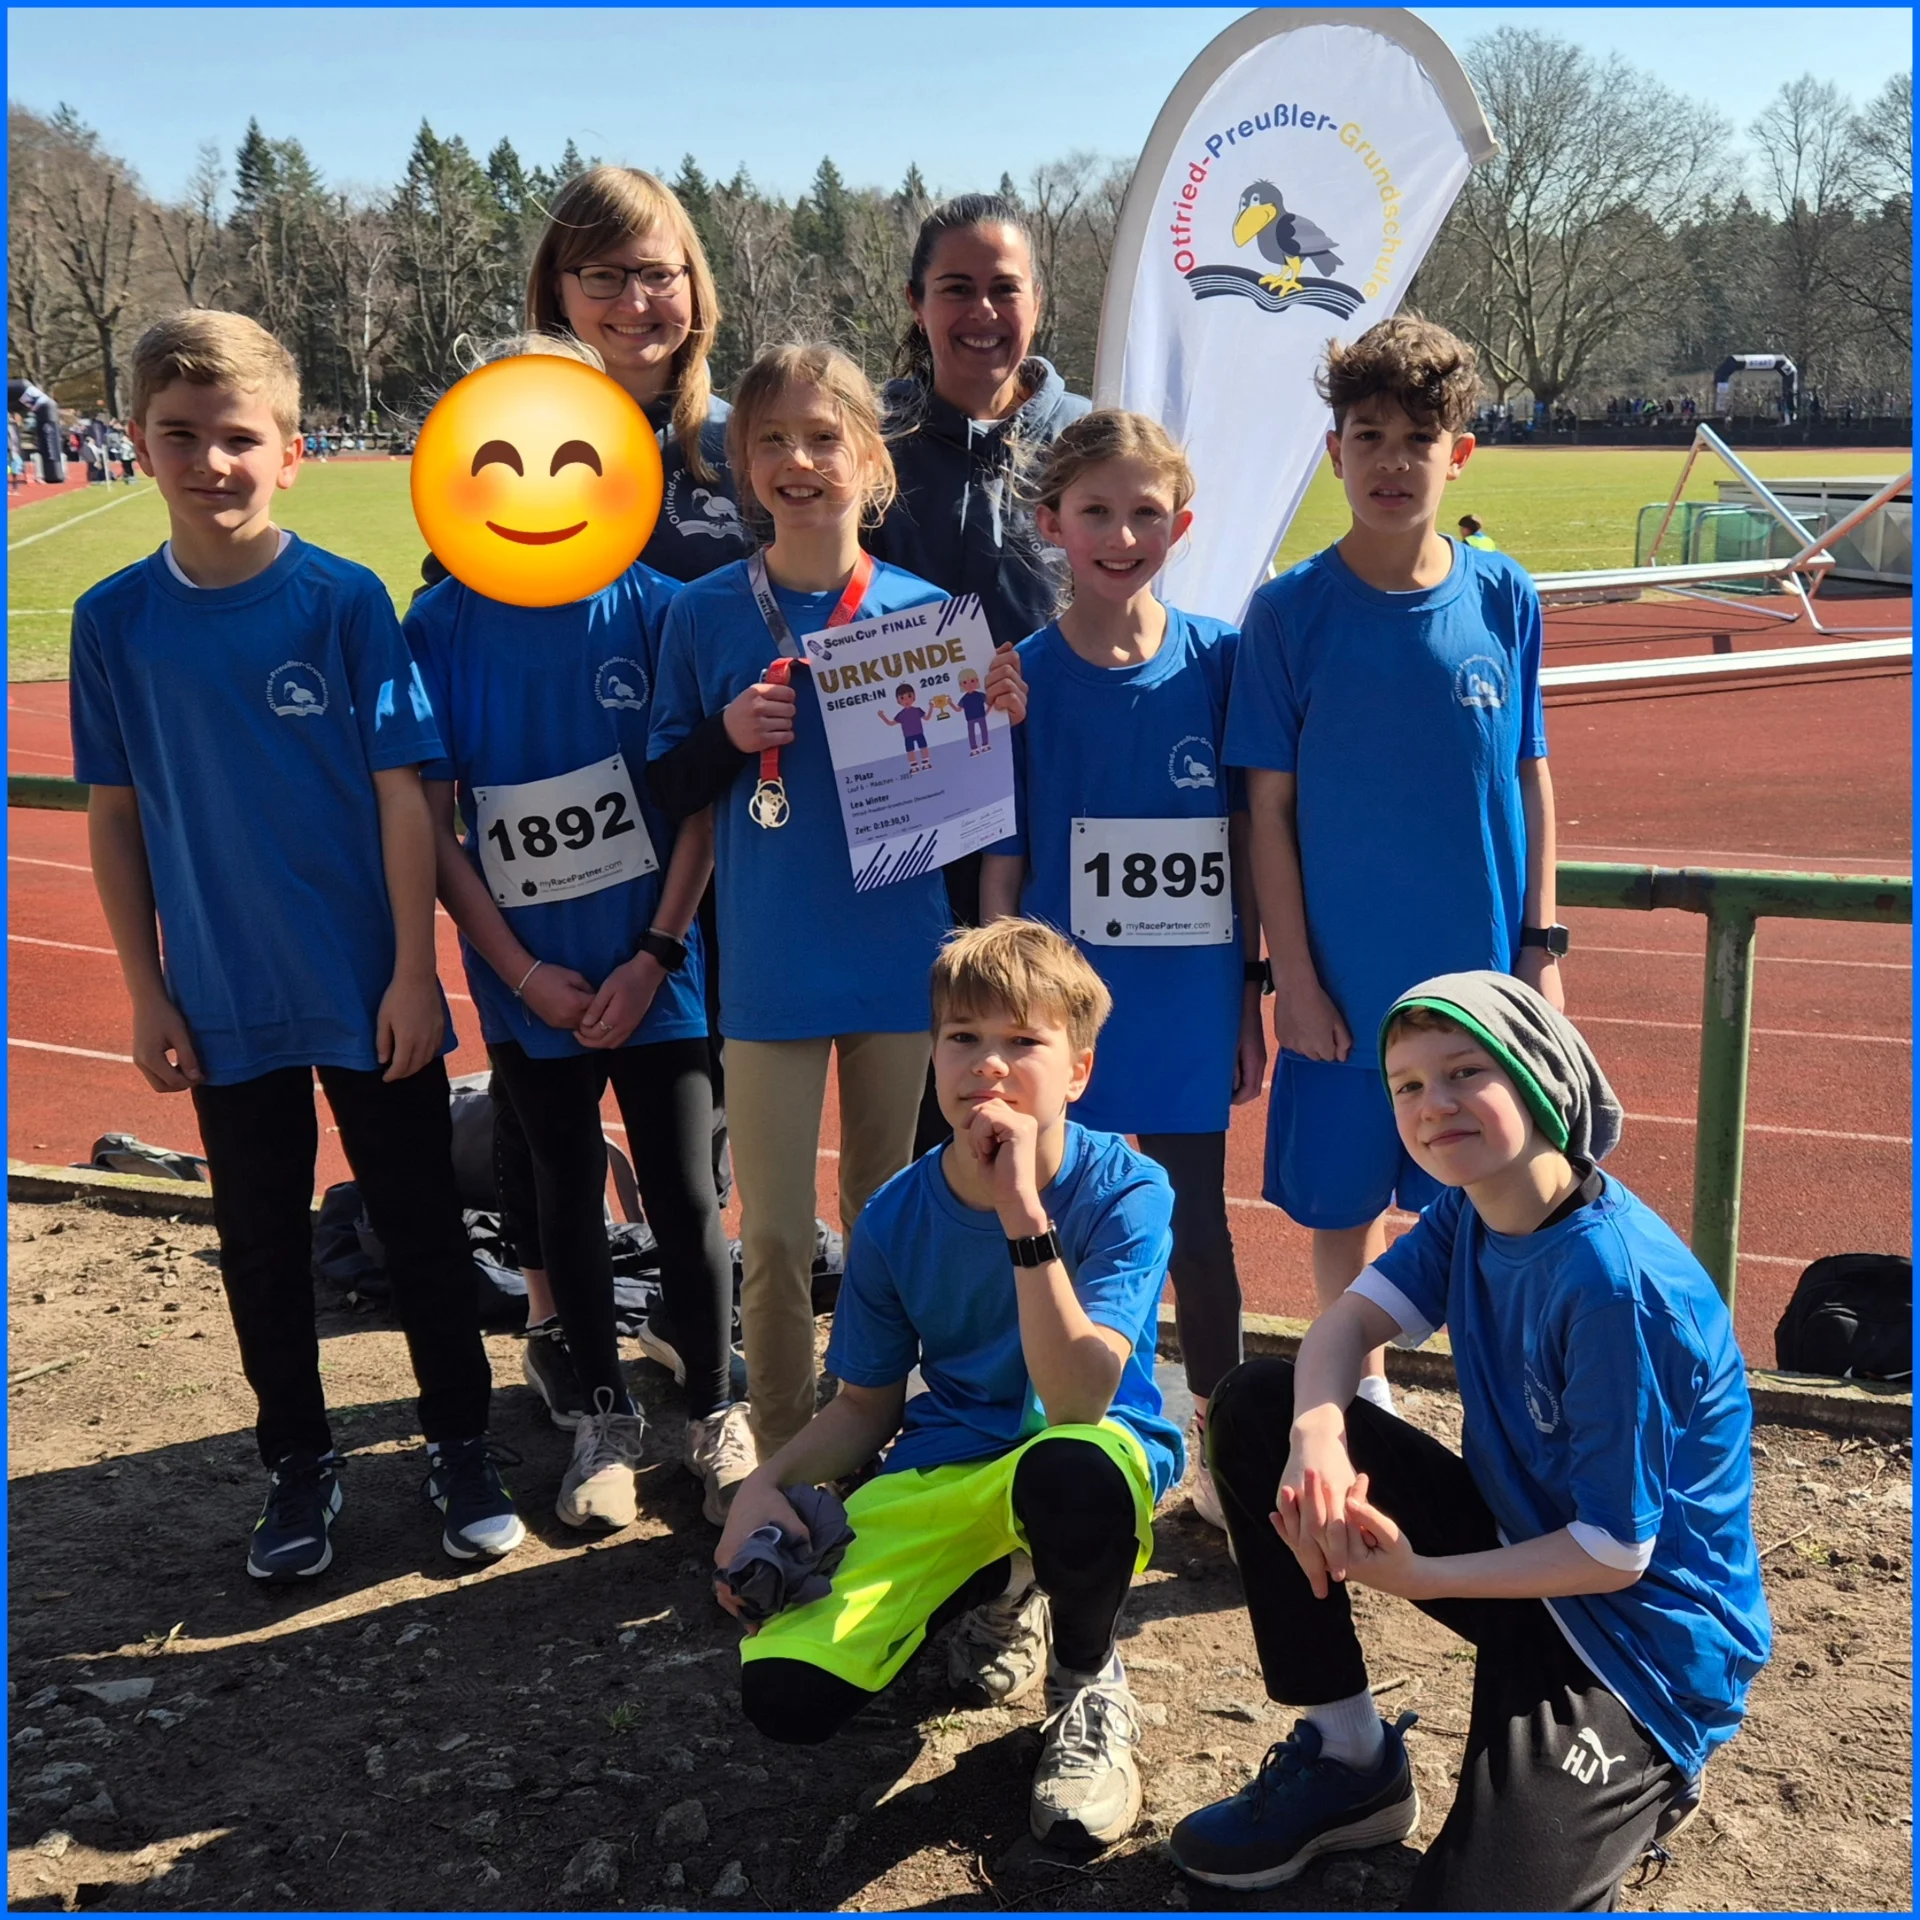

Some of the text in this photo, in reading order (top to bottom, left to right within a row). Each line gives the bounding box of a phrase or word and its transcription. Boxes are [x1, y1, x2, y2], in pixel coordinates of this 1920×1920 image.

[1170, 103, 1404, 299] Otfried-Preußler-Grundschule
[881, 614, 927, 635] FINALE
[817, 637, 966, 694] URKUNDE
[920, 672, 951, 689] 2026
[826, 688, 887, 711] SIEGER:IN
[854, 772, 874, 783] Platz
[850, 795, 889, 809] Lea Winter
[488, 791, 636, 862] 1892
[539, 859, 623, 888] myRacePartner.com
[1084, 852, 1225, 898] 1895
[1126, 921, 1211, 931] myRacePartner.com
[1561, 1744, 1600, 1784] HJ
